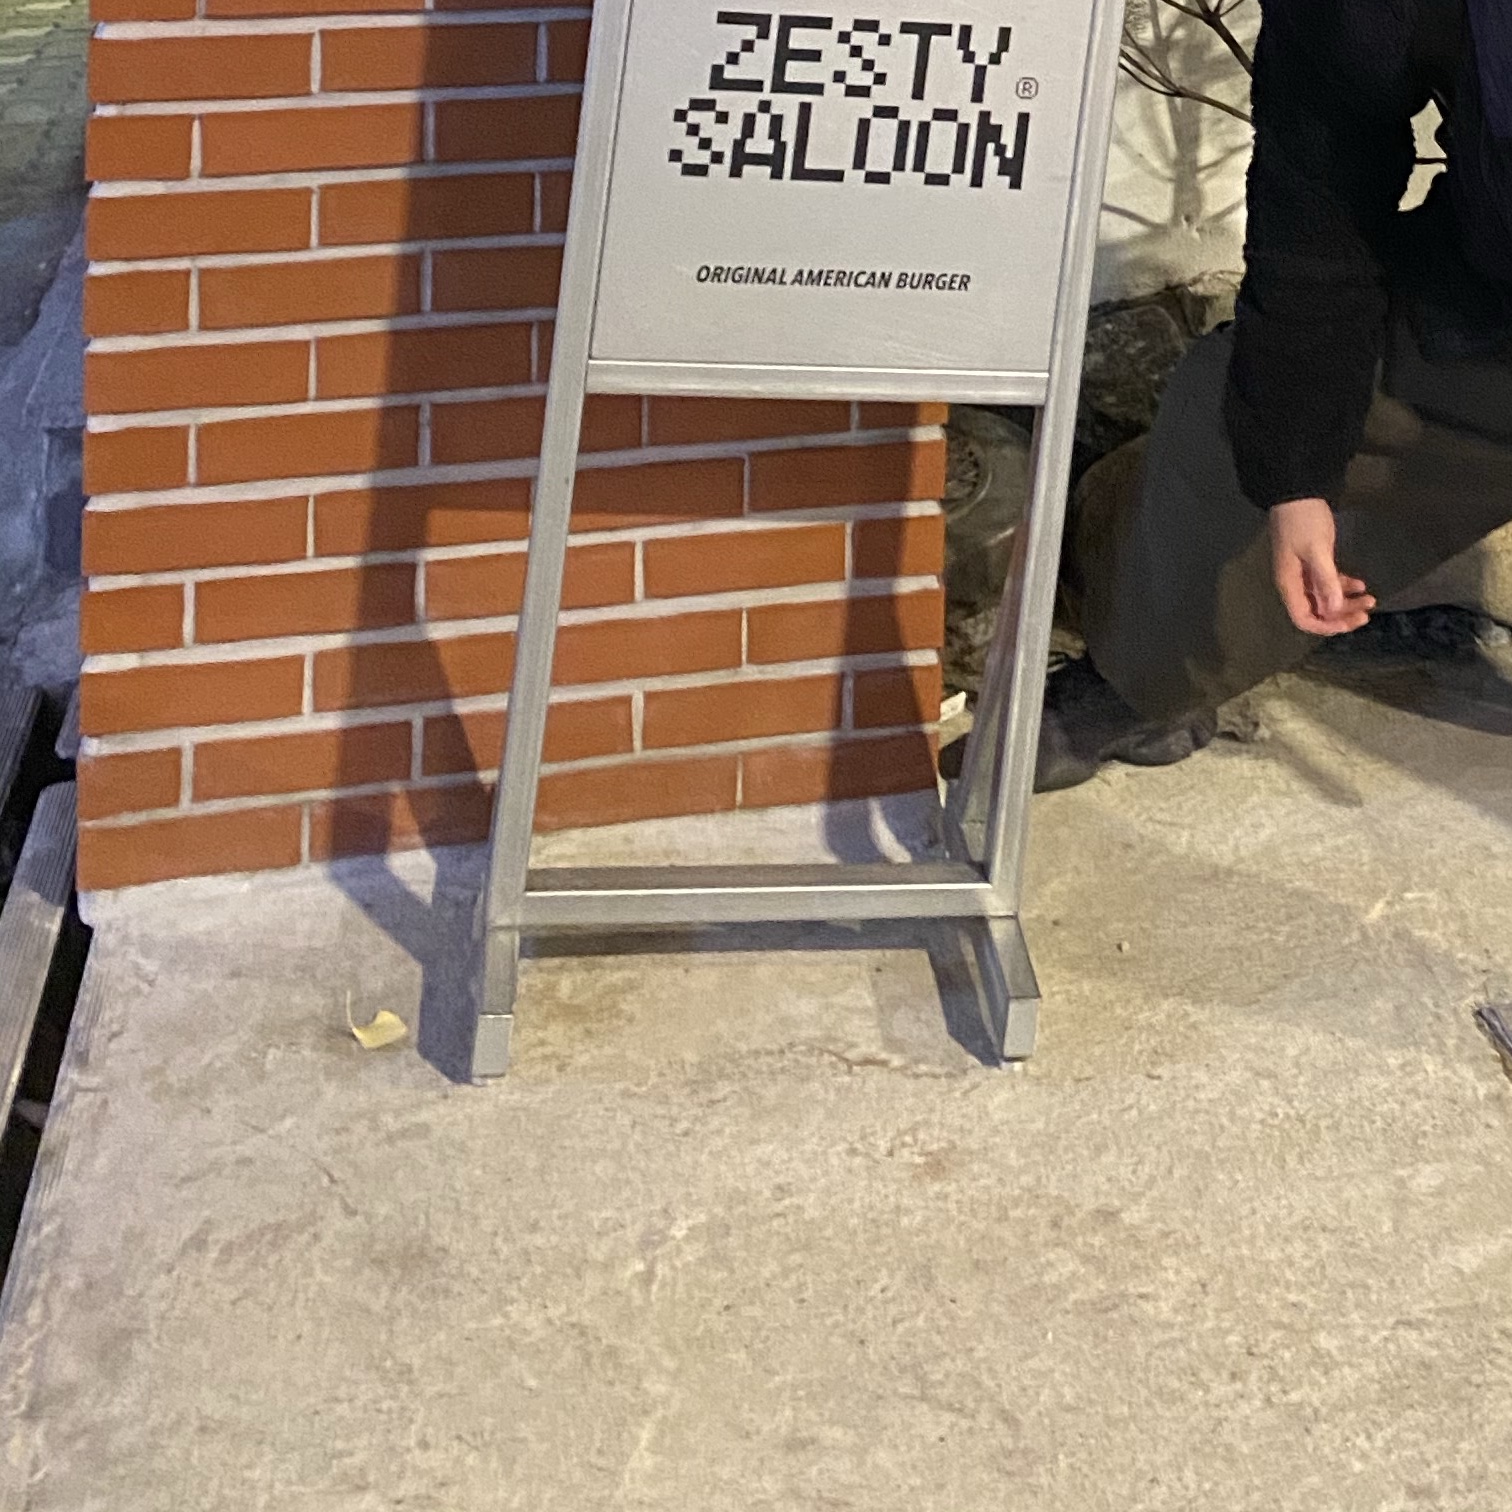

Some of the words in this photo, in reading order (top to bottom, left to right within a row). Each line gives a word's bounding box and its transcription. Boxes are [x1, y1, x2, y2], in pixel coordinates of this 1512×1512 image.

[708, 10, 1013, 104] ZESTY
[667, 97, 1031, 191] SALOON
[695, 264, 788, 286] ORIGINAL
[790, 268, 893, 290] AMERICAN
[895, 272, 972, 292] BURGER
